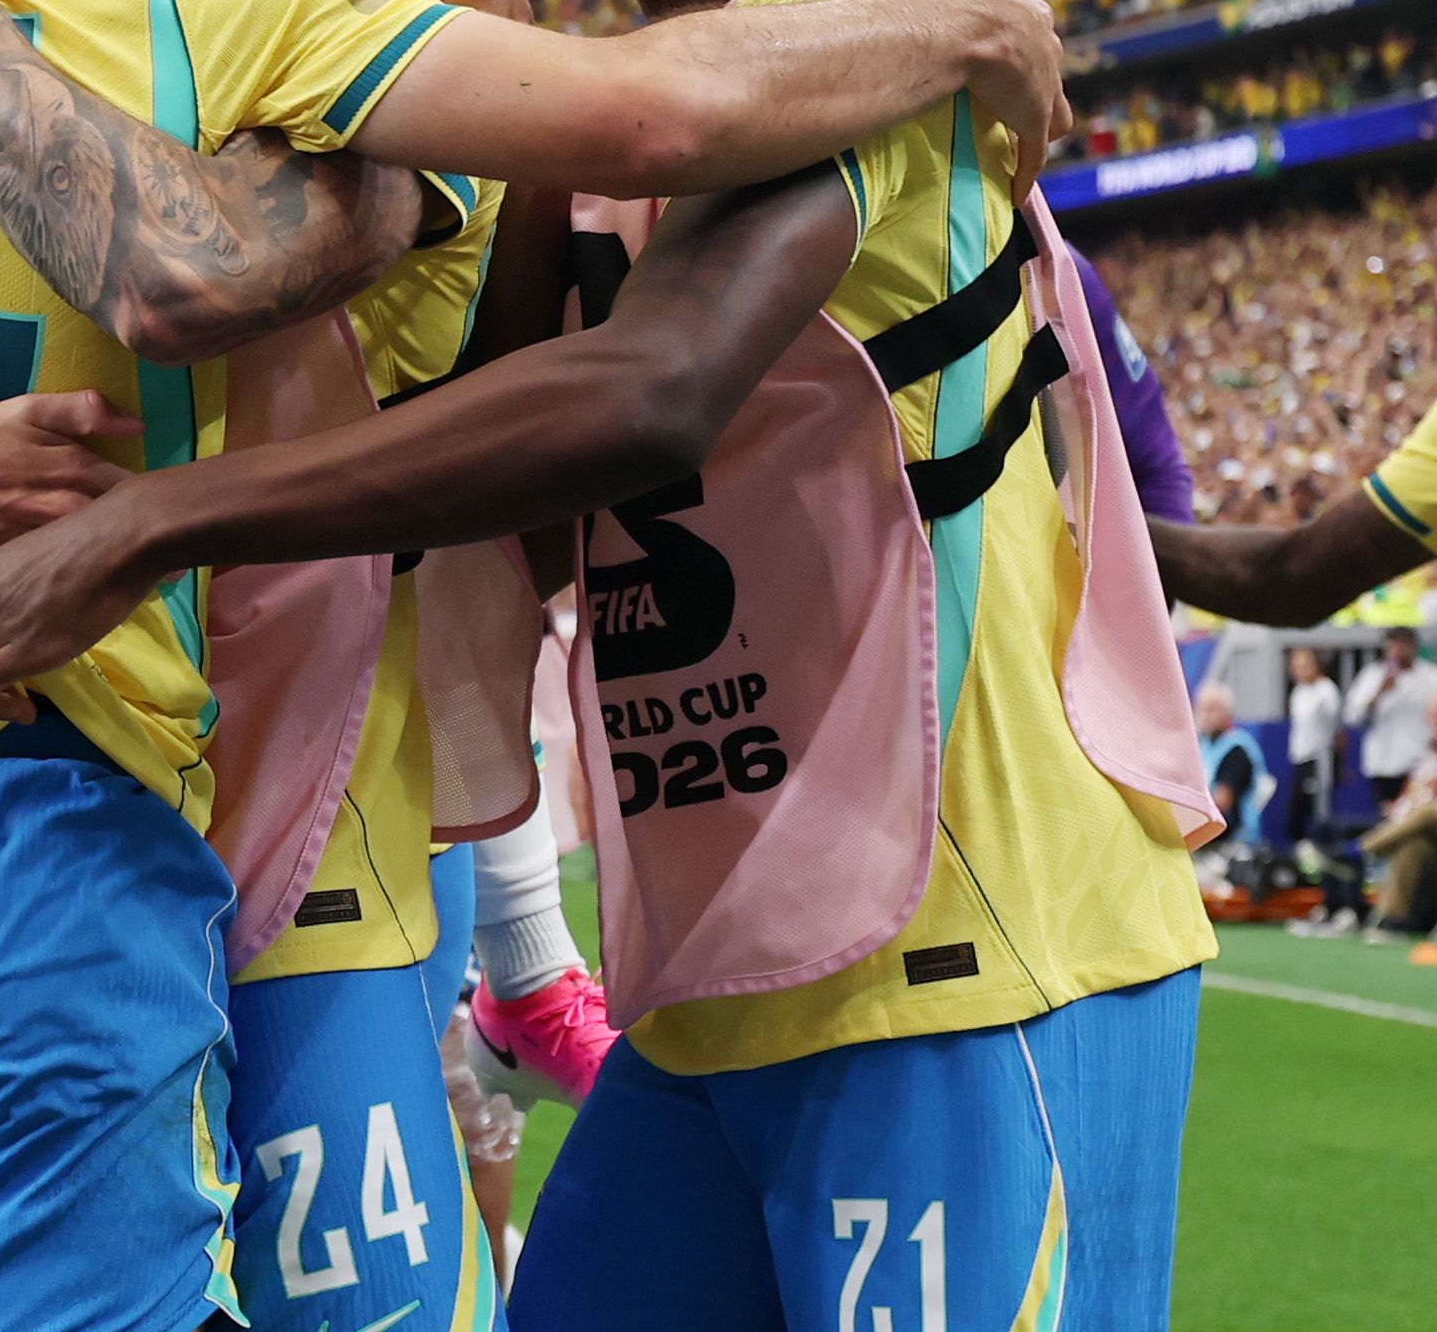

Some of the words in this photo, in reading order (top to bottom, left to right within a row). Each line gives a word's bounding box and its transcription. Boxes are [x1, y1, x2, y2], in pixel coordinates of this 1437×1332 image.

[588, 582, 667, 638] FIFA
[600, 697, 674, 743] RLD
[679, 672, 767, 726] CUP
[610, 725, 788, 819] 026
[257, 1101, 431, 1299] 24
